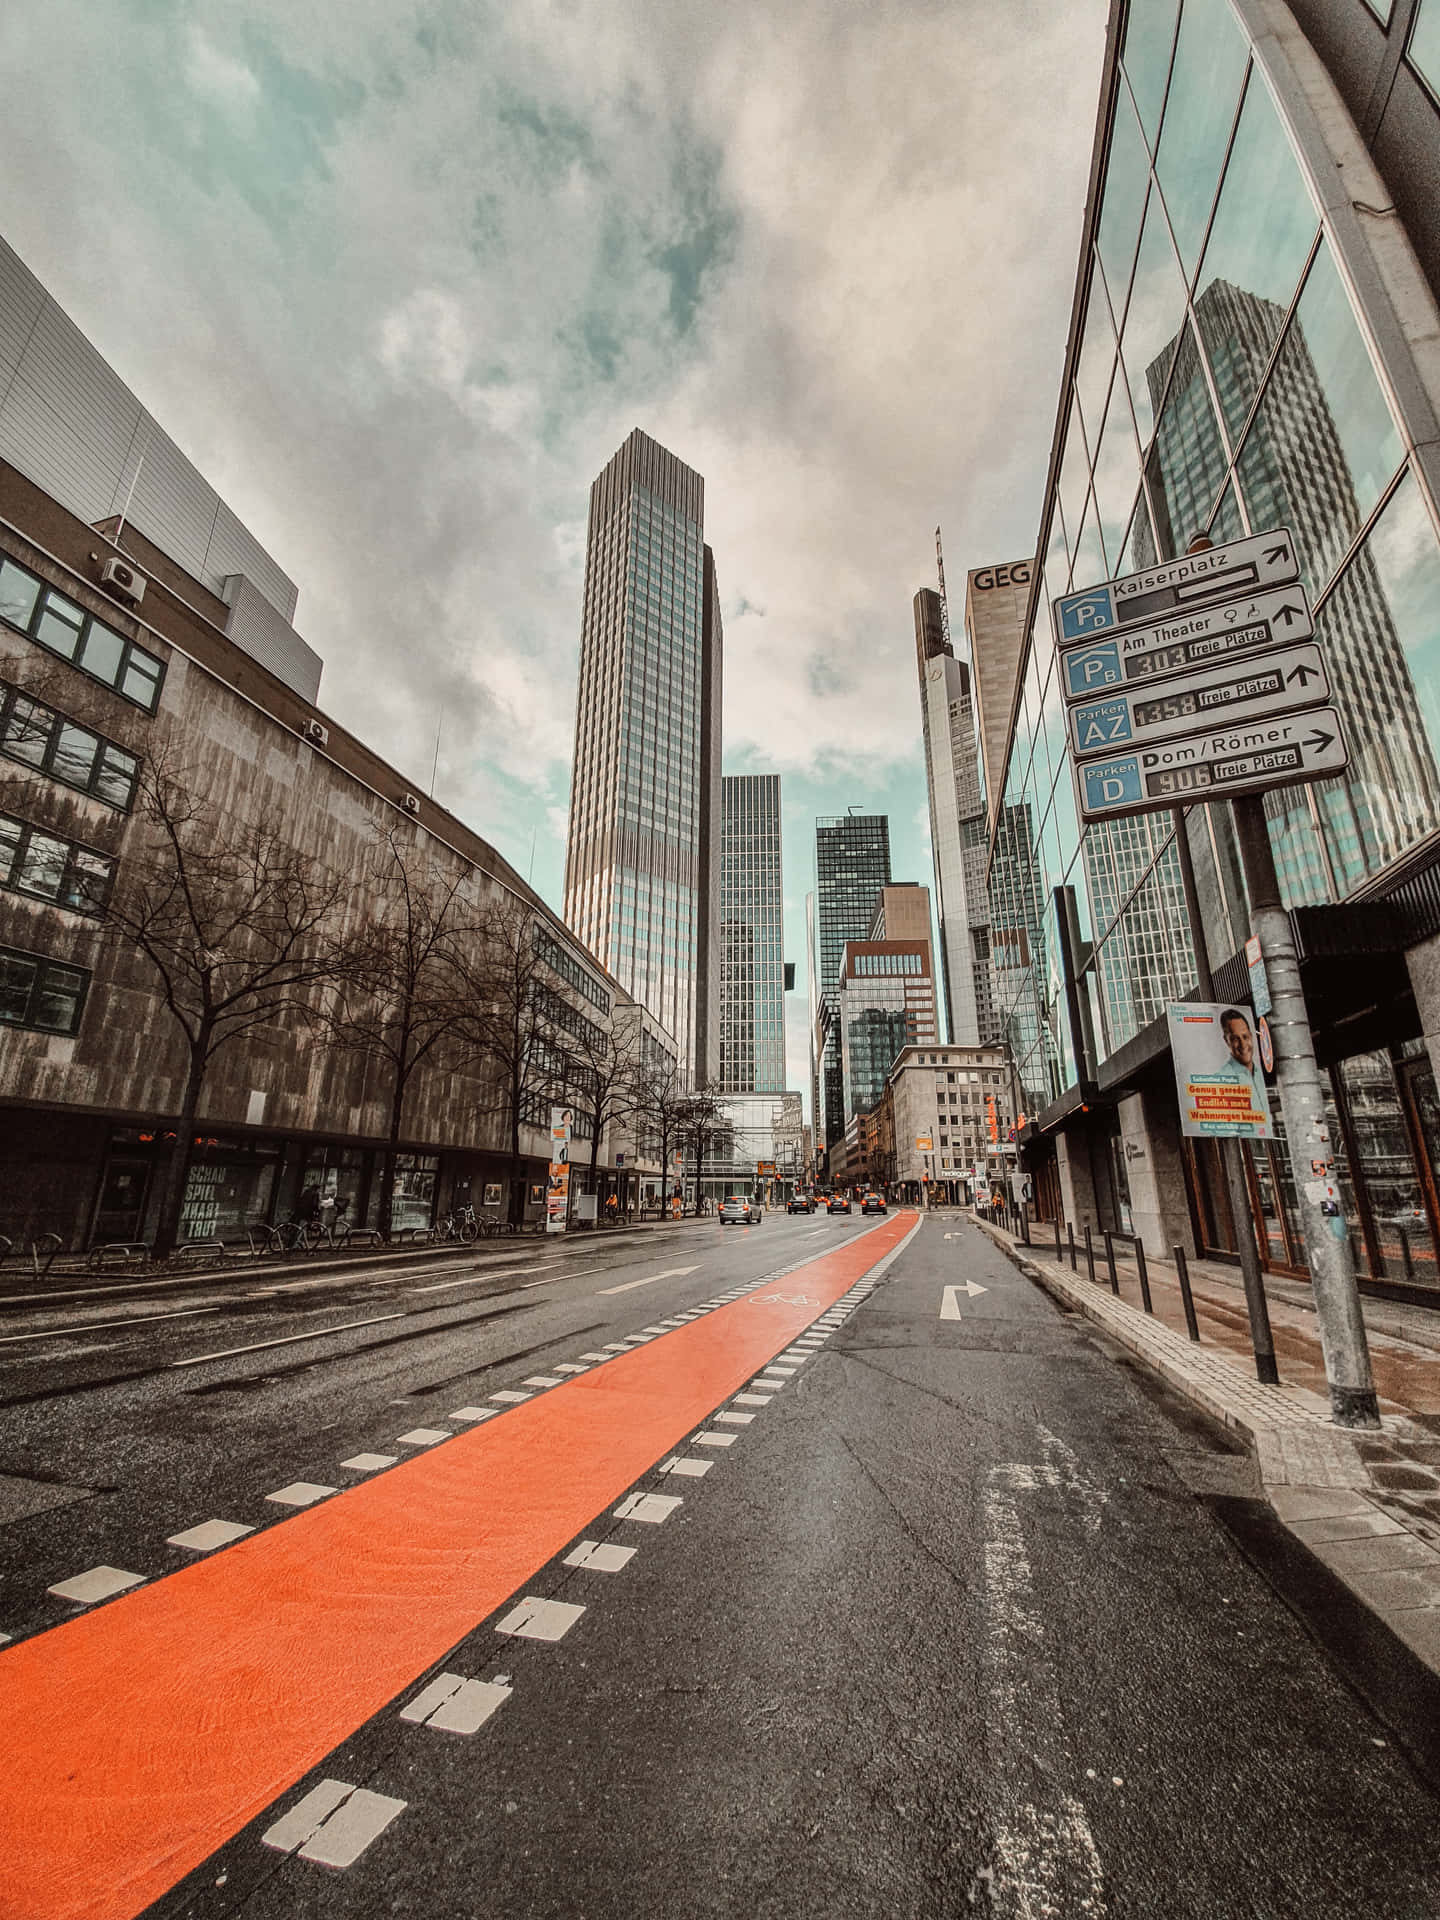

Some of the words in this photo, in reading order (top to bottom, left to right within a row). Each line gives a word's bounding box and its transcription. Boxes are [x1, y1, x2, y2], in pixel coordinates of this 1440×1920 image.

[974, 563, 1030, 590] GEG
[1113, 553, 1229, 598] Kaiserplatz
[1122, 637, 1146, 653] Am
[1152, 617, 1211, 643] Theater
[1189, 640, 1220, 657] freie
[1225, 628, 1265, 647] Plätze
[1200, 689, 1231, 706] freie
[1236, 677, 1278, 698] Plätze
[1078, 703, 1125, 721] Parken
[1084, 714, 1128, 745] AZ
[1086, 763, 1136, 780] Parken
[1215, 764, 1248, 779] freie
[1252, 751, 1296, 770] Plätze
[1101, 778, 1125, 802] D
[188, 1165, 226, 1183] SCHAU
[184, 1183, 216, 1201] SPIEL
